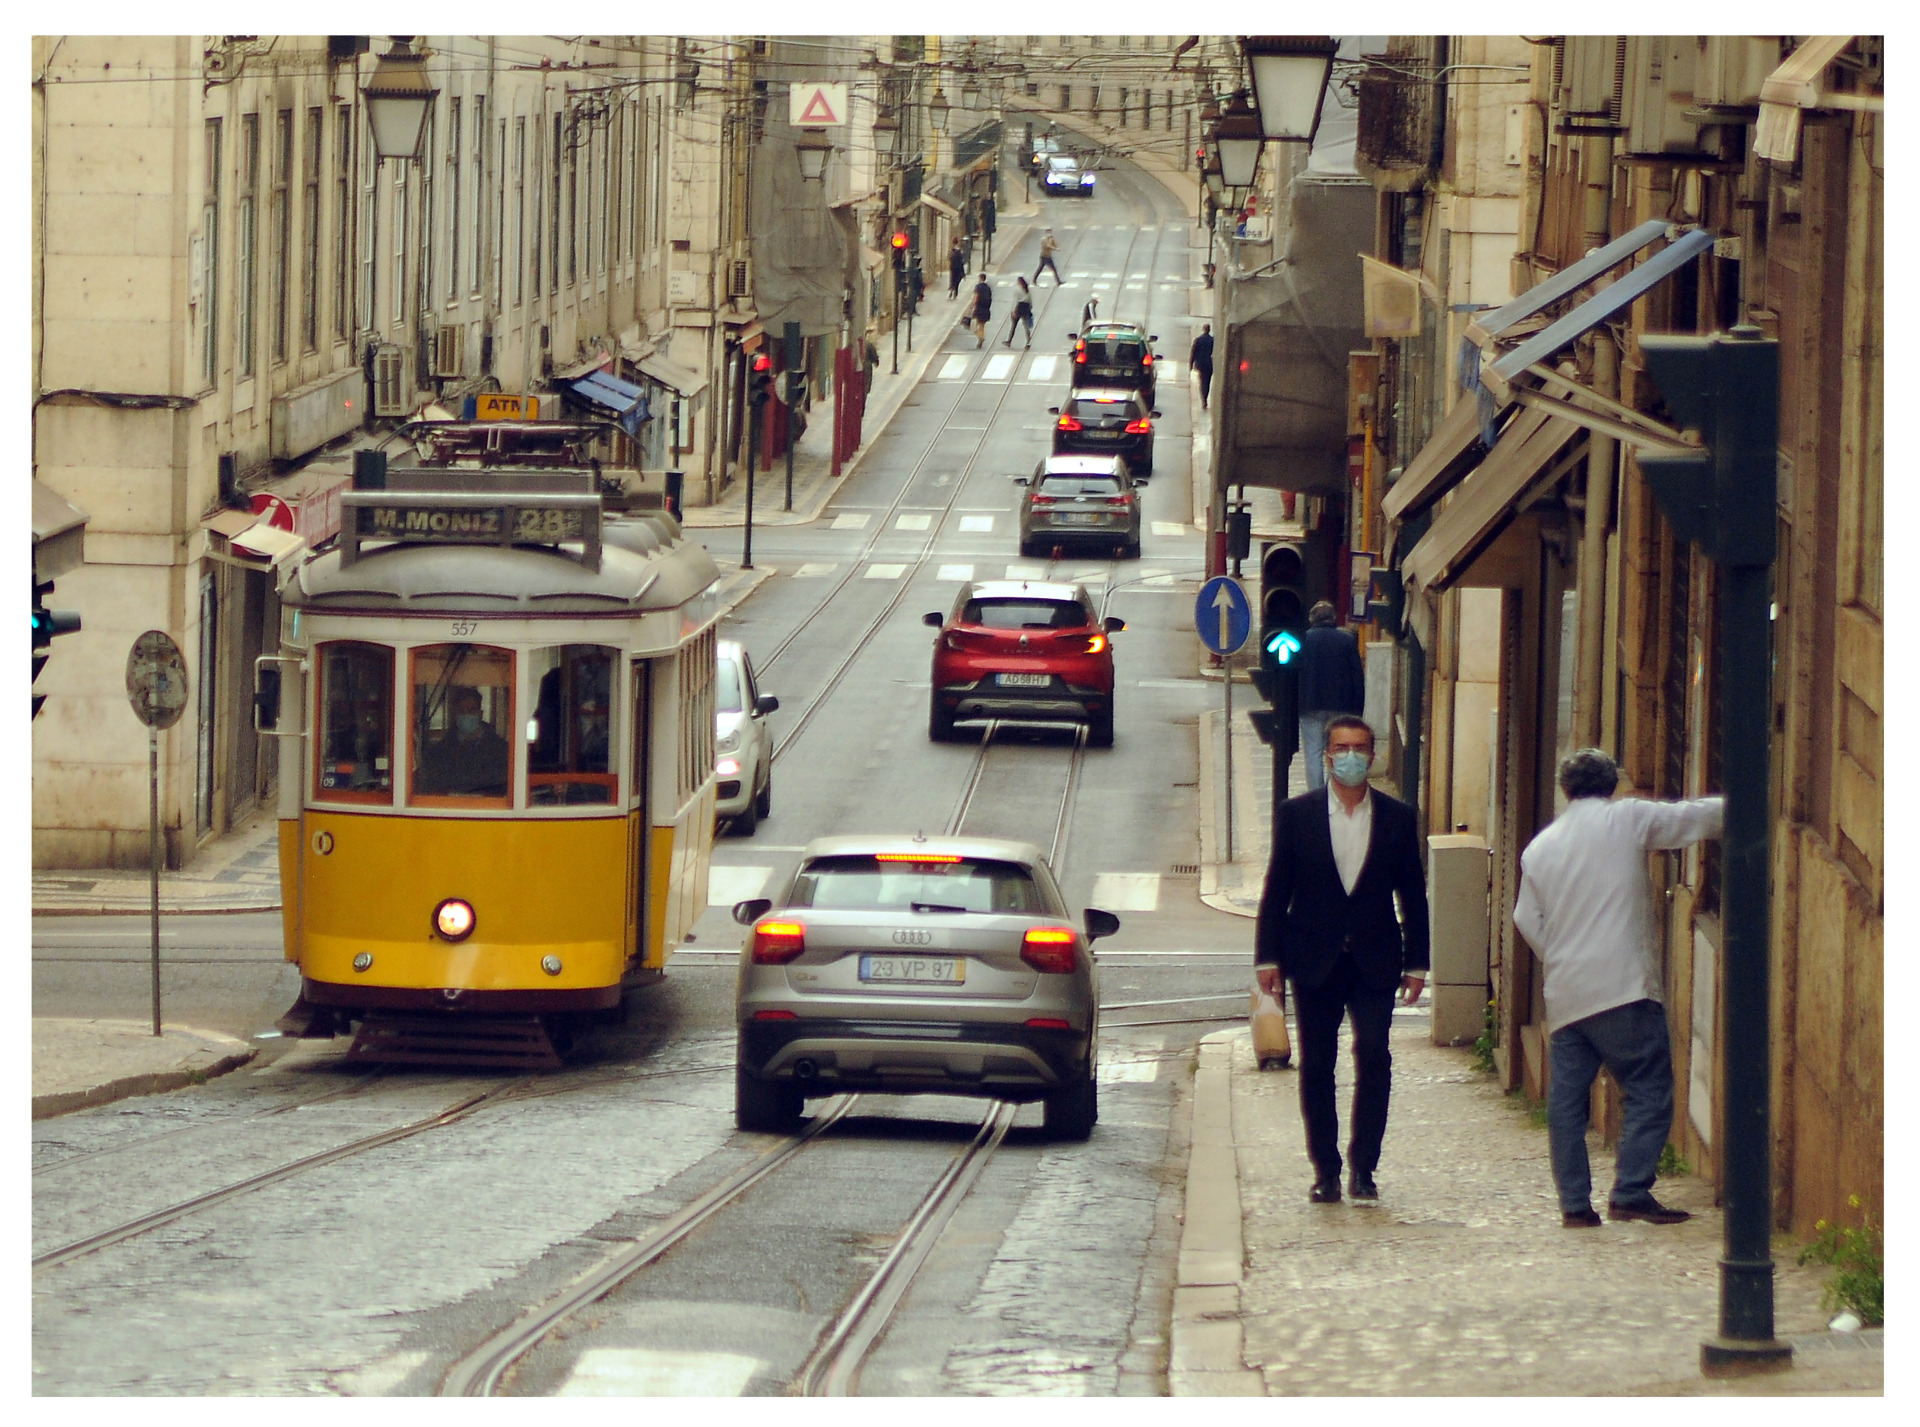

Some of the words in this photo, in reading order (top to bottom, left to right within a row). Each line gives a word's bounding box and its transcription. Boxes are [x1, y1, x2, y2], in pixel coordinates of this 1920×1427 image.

[487, 399, 527, 412] ATM
[374, 508, 499, 533] M.MONIZ
[451, 622, 477, 636] 557
